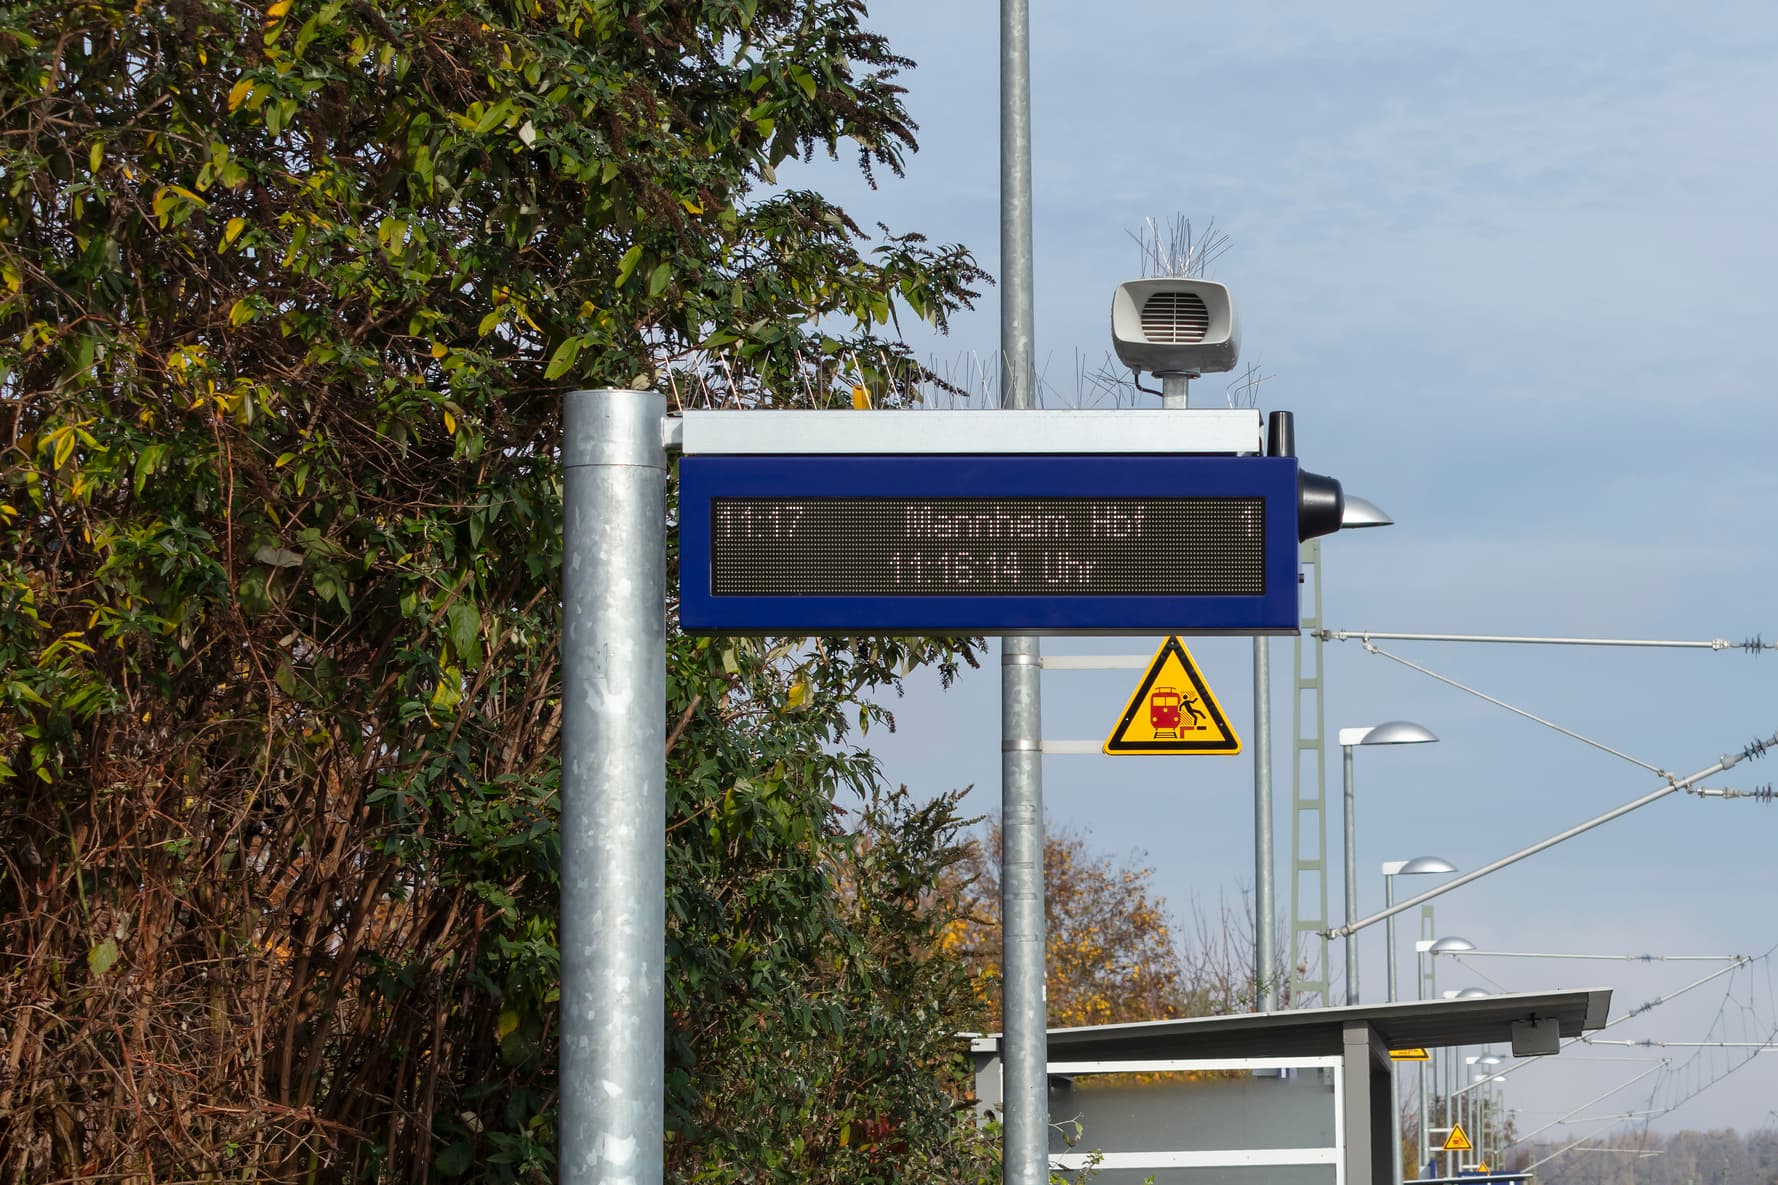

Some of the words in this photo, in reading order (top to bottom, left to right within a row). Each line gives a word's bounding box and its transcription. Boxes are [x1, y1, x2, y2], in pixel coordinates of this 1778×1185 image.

[720, 506, 803, 538] 11:17
[906, 506, 1069, 538] Mannheim
[1092, 506, 1145, 538] Hbf
[1240, 506, 1252, 538] 1
[889, 552, 1021, 584] 11:16:14
[1044, 552, 1097, 584] Uhr
